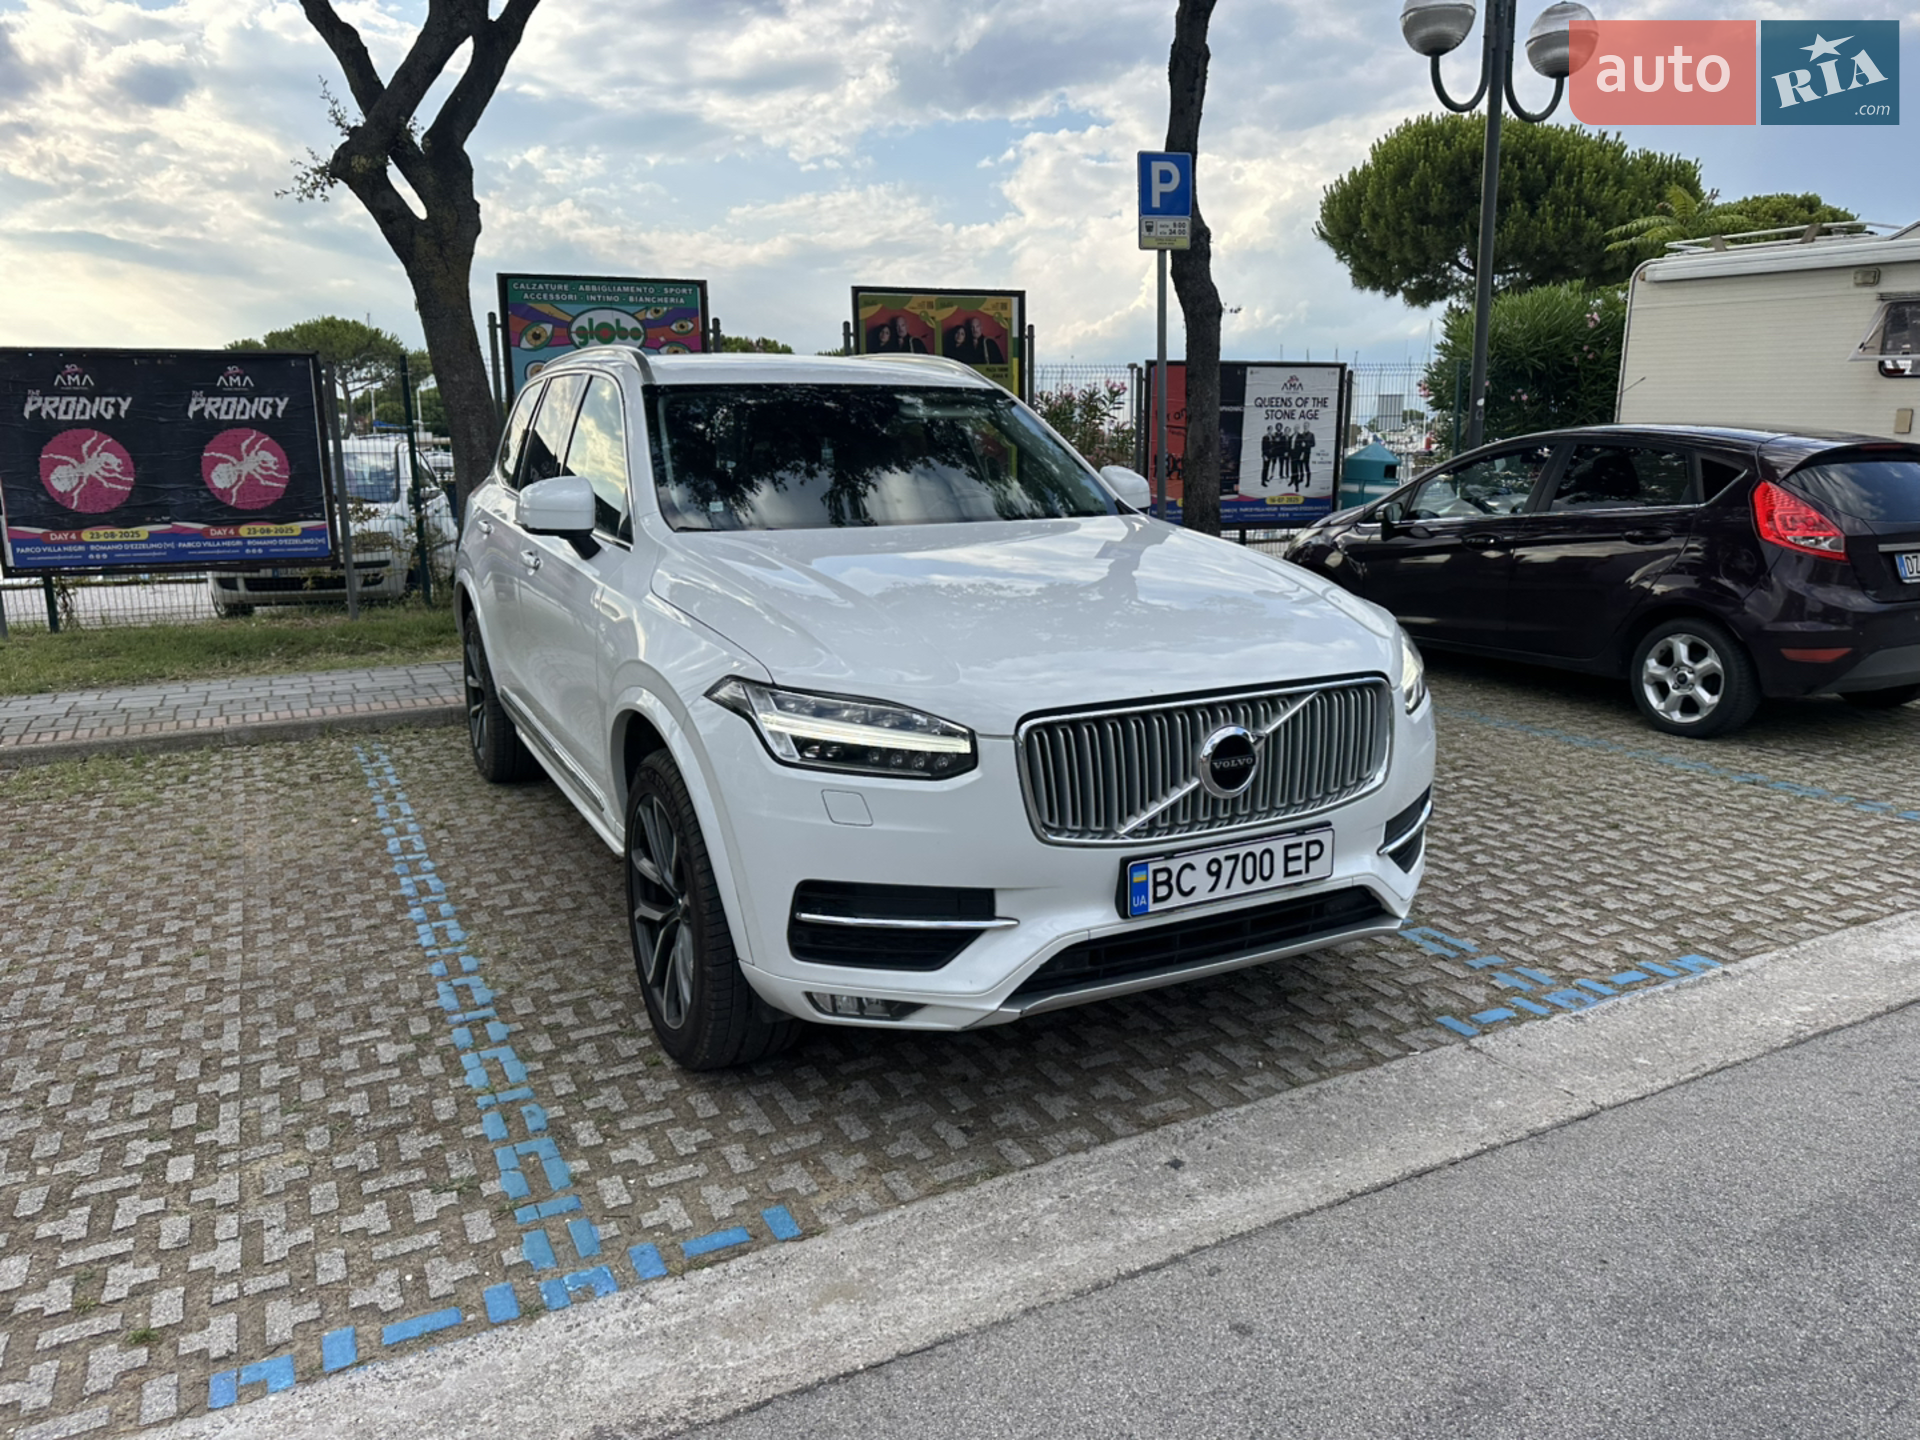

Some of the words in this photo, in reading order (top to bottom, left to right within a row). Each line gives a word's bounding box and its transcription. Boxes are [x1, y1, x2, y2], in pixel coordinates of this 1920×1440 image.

[1151, 161, 1180, 208] P
[512, 283, 569, 291] CALZATURE
[578, 284, 655, 293] ABBIGLIAMENTO
[523, 292, 577, 301] ACCESSORI
[586, 294, 620, 302] INTIMO
[628, 295, 685, 304] BIANCHERIA
[575, 317, 643, 347] globo
[23, 396, 133, 420] PRODIGY
[187, 396, 289, 420] PRODIGY
[1254, 397, 1293, 408] QUEENS
[1295, 397, 1309, 408] OF
[1312, 397, 1329, 408] THE
[1265, 409, 1296, 420] STONE
[1299, 409, 1320, 420] AGE
[50, 532, 70, 541] DAY
[70, 532, 77, 541] 4
[89, 530, 141, 540] 23-08-2025
[210, 528, 227, 536] DAY
[227, 528, 235, 536] 4
[1213, 757, 1253, 769] VOLVO
[1152, 862, 1197, 904] BC
[1206, 848, 1275, 893] 9700
[1283, 839, 1325, 878] EP
[1132, 895, 1147, 907] UA
